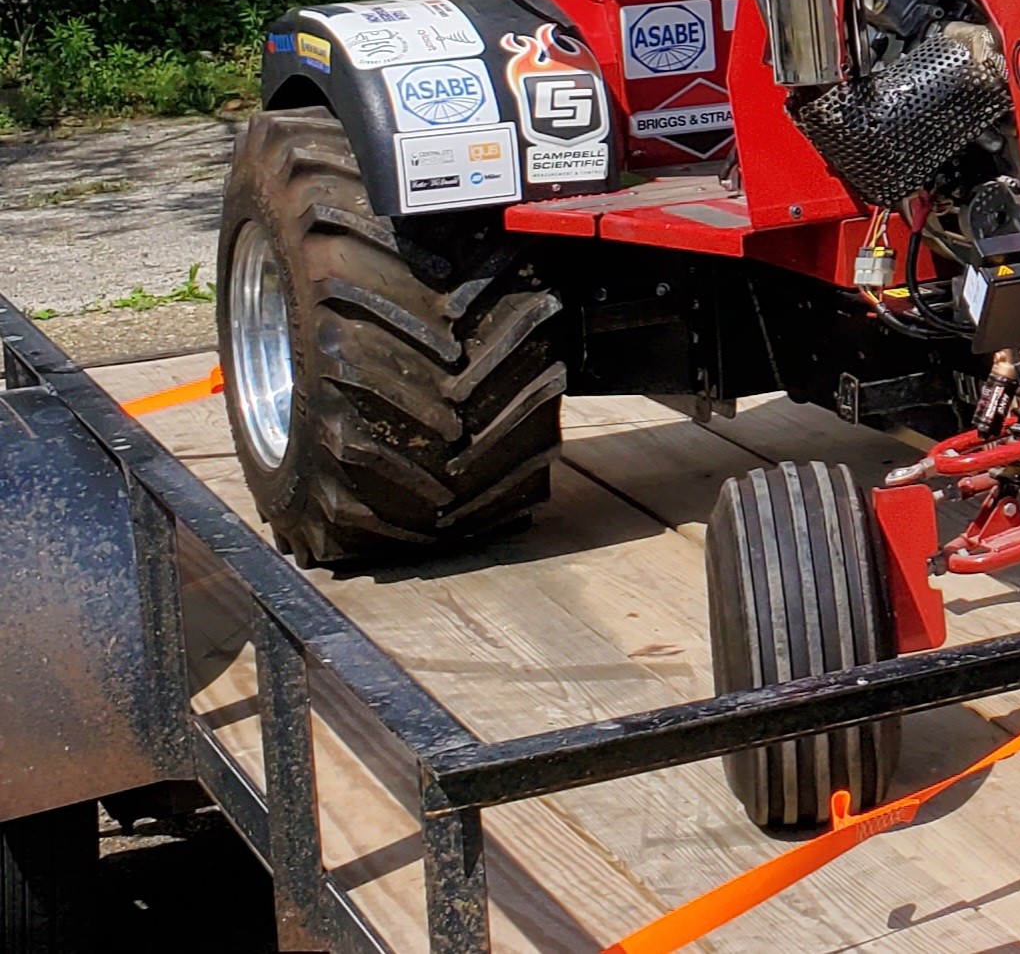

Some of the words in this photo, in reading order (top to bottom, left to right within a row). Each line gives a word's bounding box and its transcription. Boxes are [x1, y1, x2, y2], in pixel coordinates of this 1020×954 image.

[634, 22, 700, 49] ASABE
[405, 76, 479, 101] ASABE
[637, 115, 686, 131] BRIGGS
[689, 114, 699, 125] &
[532, 150, 605, 161] CAMPBELL
[532, 159, 605, 170] SCIENTIFIC
